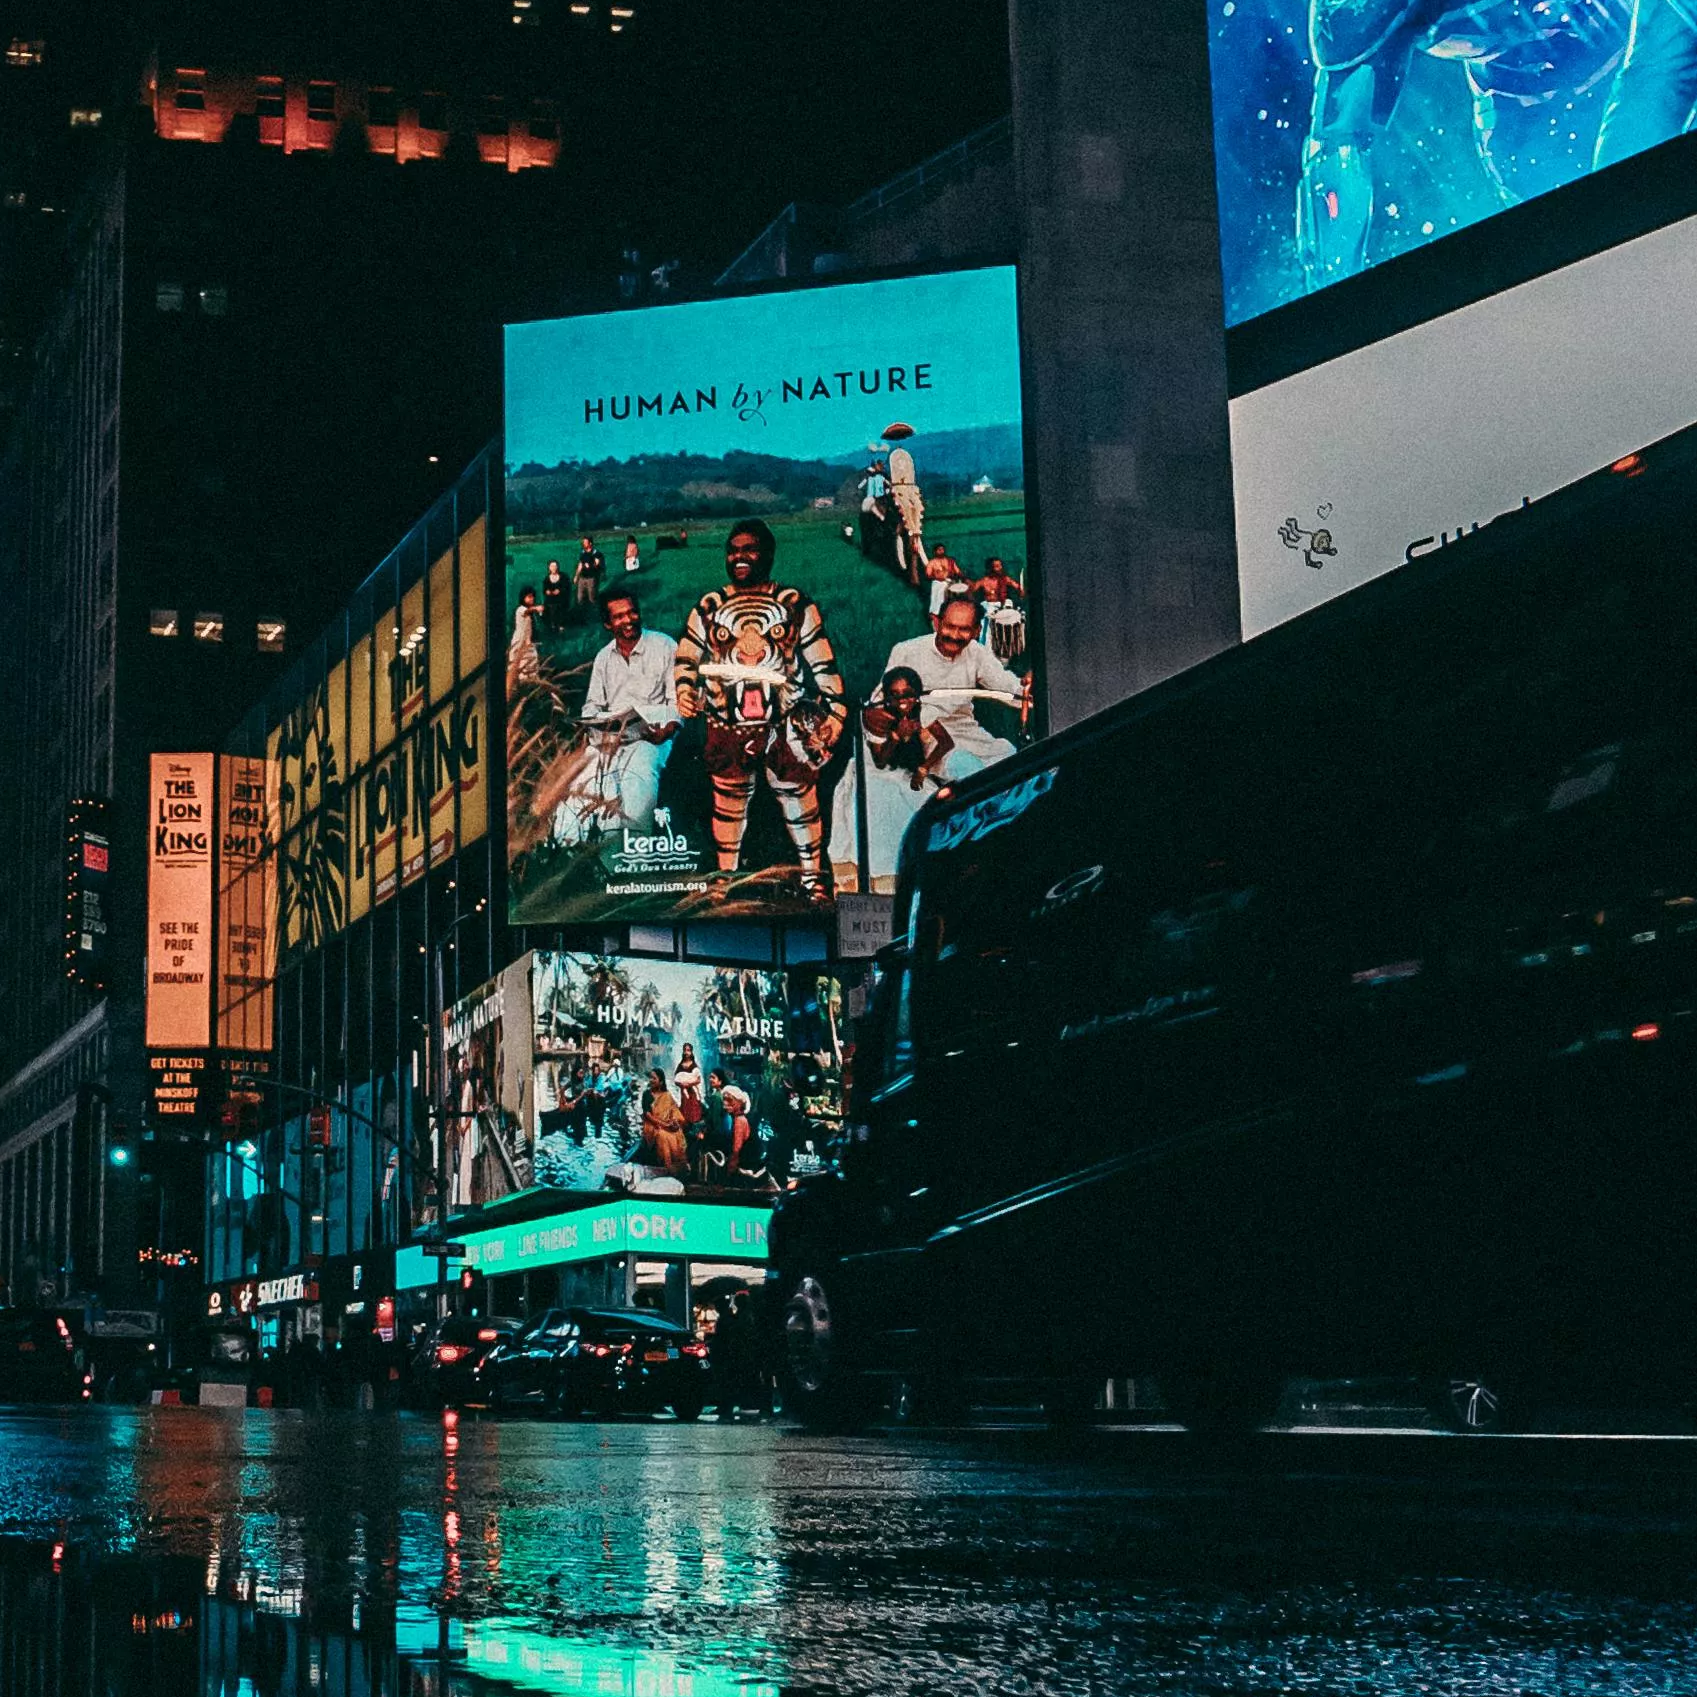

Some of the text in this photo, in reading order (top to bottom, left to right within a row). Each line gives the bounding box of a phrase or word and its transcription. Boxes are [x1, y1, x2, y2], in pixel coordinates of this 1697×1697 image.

[584, 363, 932, 426] HUMAN by NATURE
[165, 780, 195, 795] THE
[159, 798, 202, 824] LION
[155, 825, 208, 856] KING
[624, 820, 688, 853] kerala
[606, 881, 707, 894] keralatourism.org
[159, 922, 199, 934] SEE THE
[853, 921, 886, 933] MUST
[164, 939, 194, 951] PRIDE
[172, 956, 185, 967] OF
[153, 972, 205, 984] BROADWAY
[597, 1005, 784, 1039] HUMAN NATURE
[150, 1058, 205, 1069] GET TICKETS
[162, 1073, 191, 1084] AT THE
[518, 1232, 538, 1257] LINE
[592, 1216, 617, 1242] NEW
[620, 1213, 687, 1242] YORK
